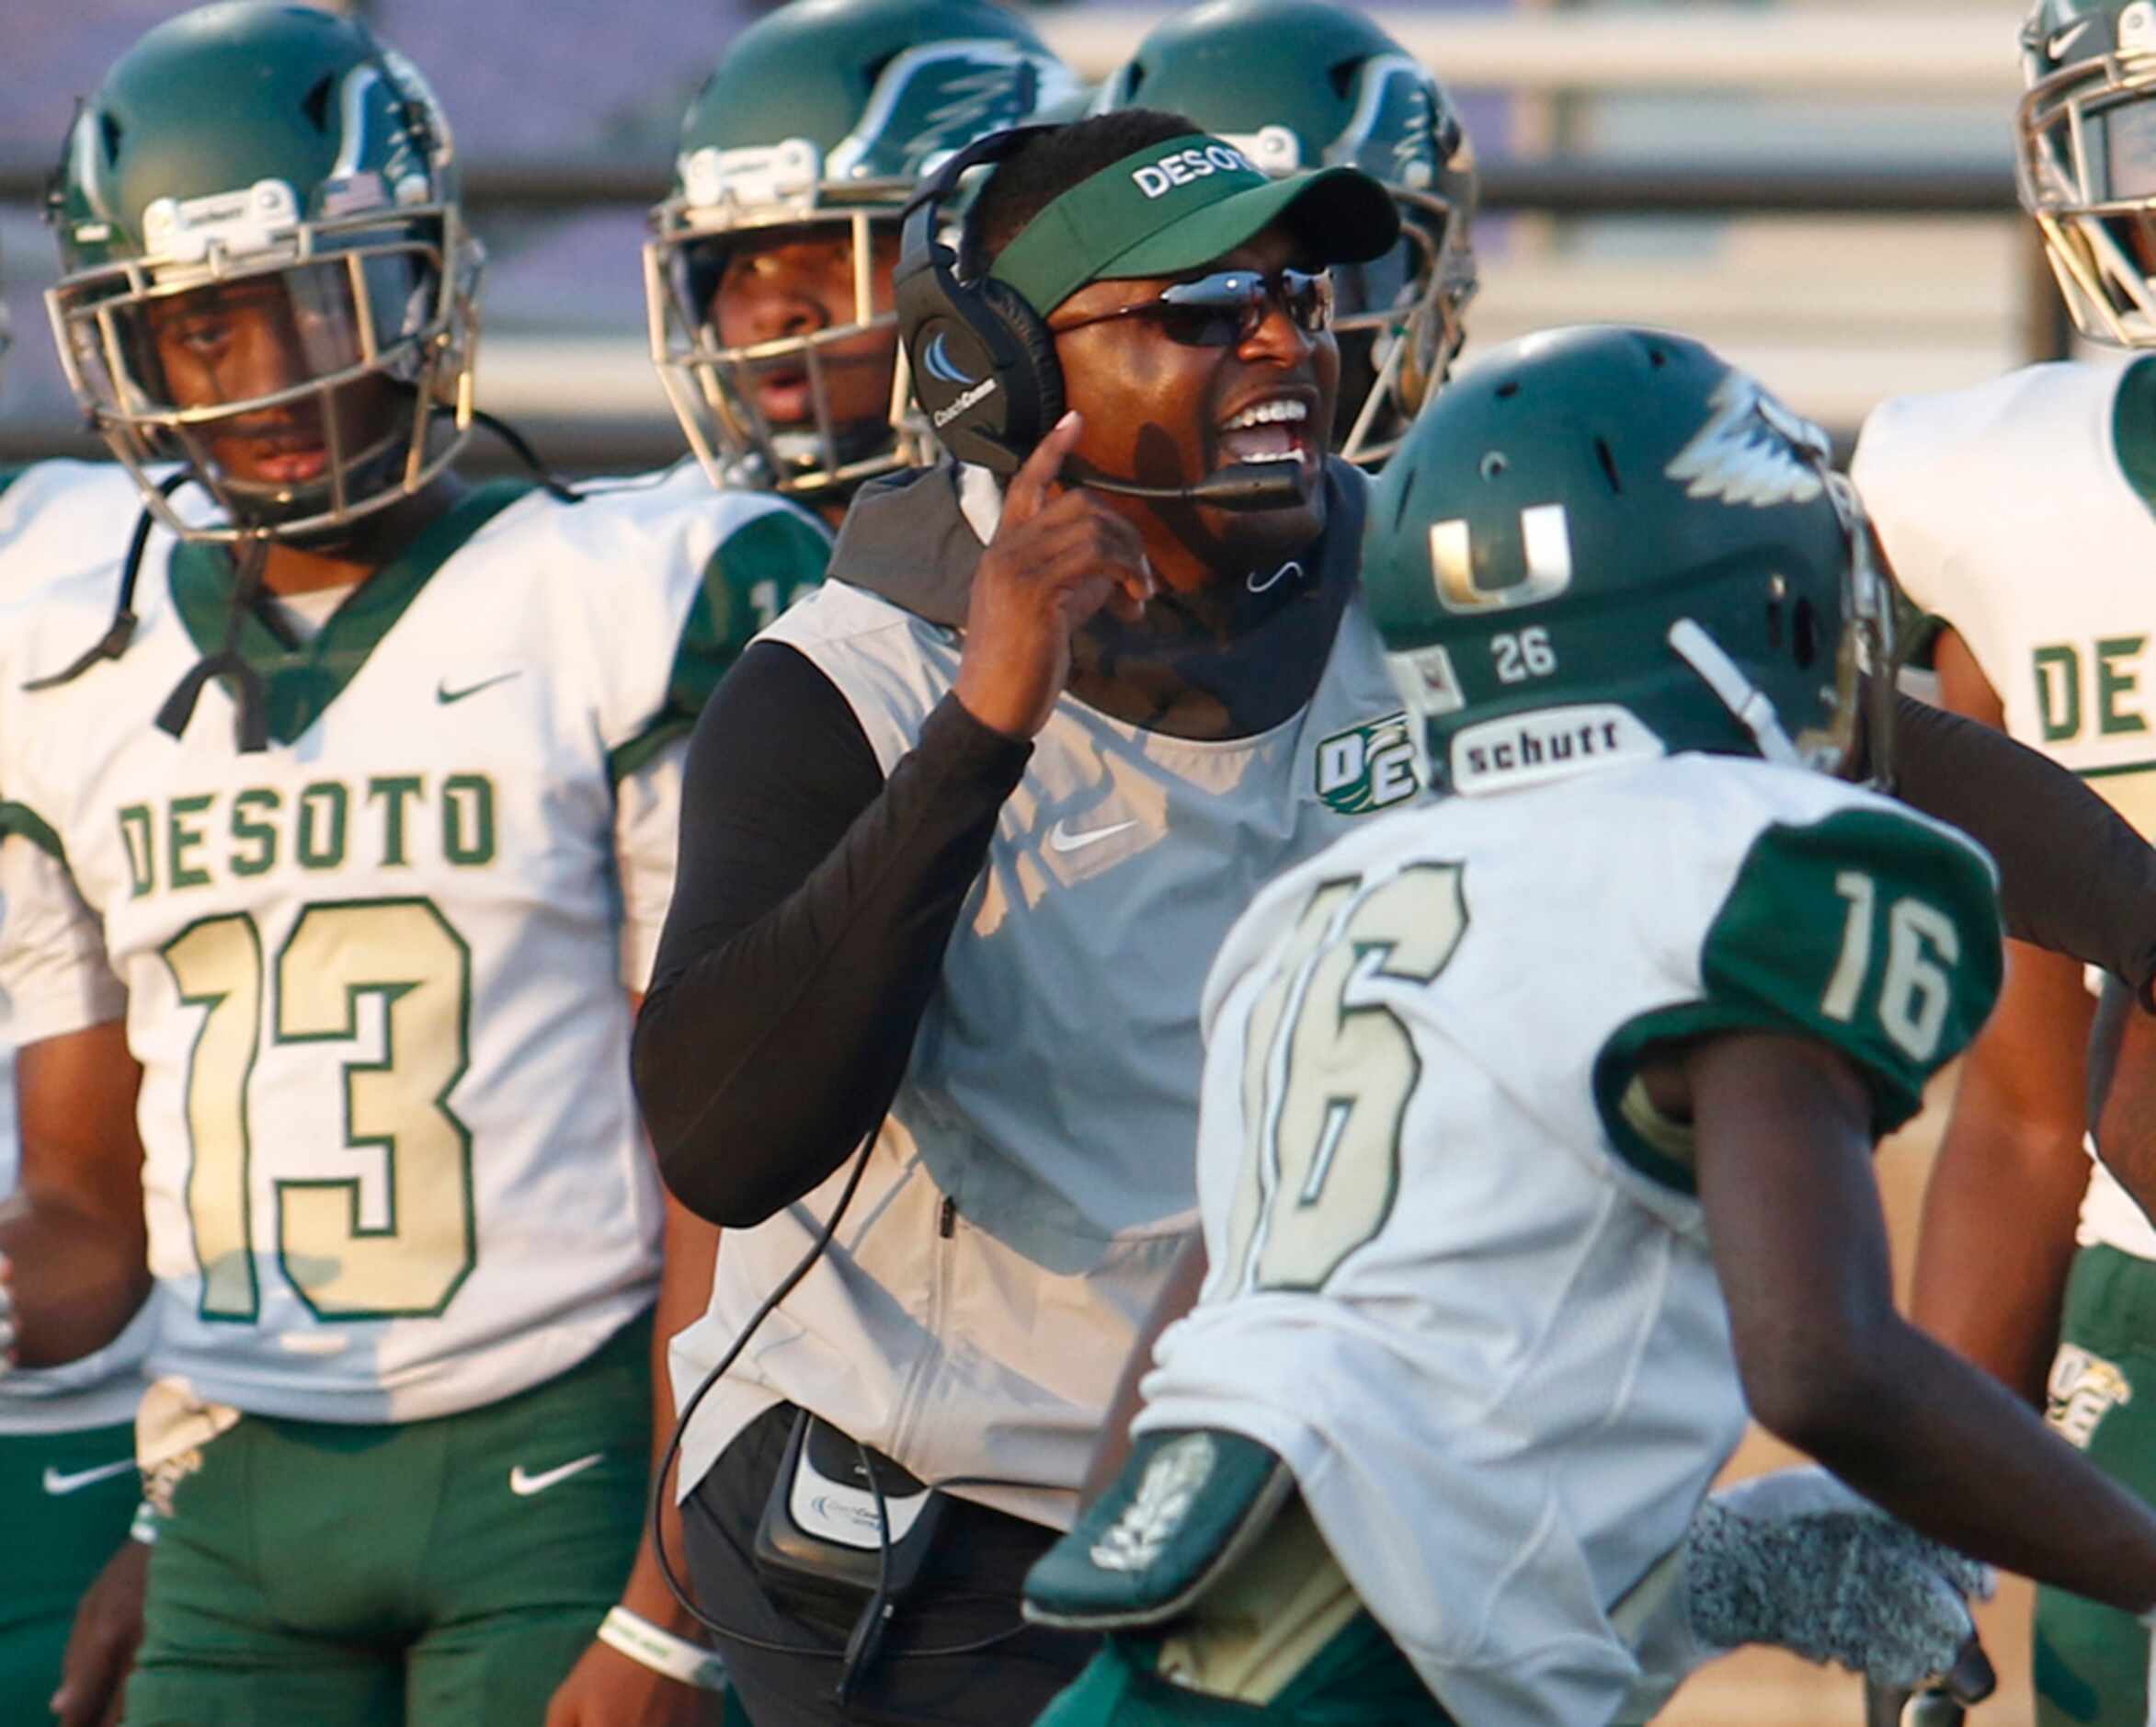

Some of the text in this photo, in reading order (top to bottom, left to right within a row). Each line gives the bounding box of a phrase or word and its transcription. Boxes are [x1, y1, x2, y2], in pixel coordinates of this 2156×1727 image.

[1430, 502, 1572, 614] U
[1490, 626, 1557, 683] 26
[2032, 636, 2150, 742] DE
[1466, 721, 1618, 775] schutt
[118, 772, 495, 898] DESOTO
[1821, 871, 1960, 1062] 16
[160, 896, 476, 1323] 13
